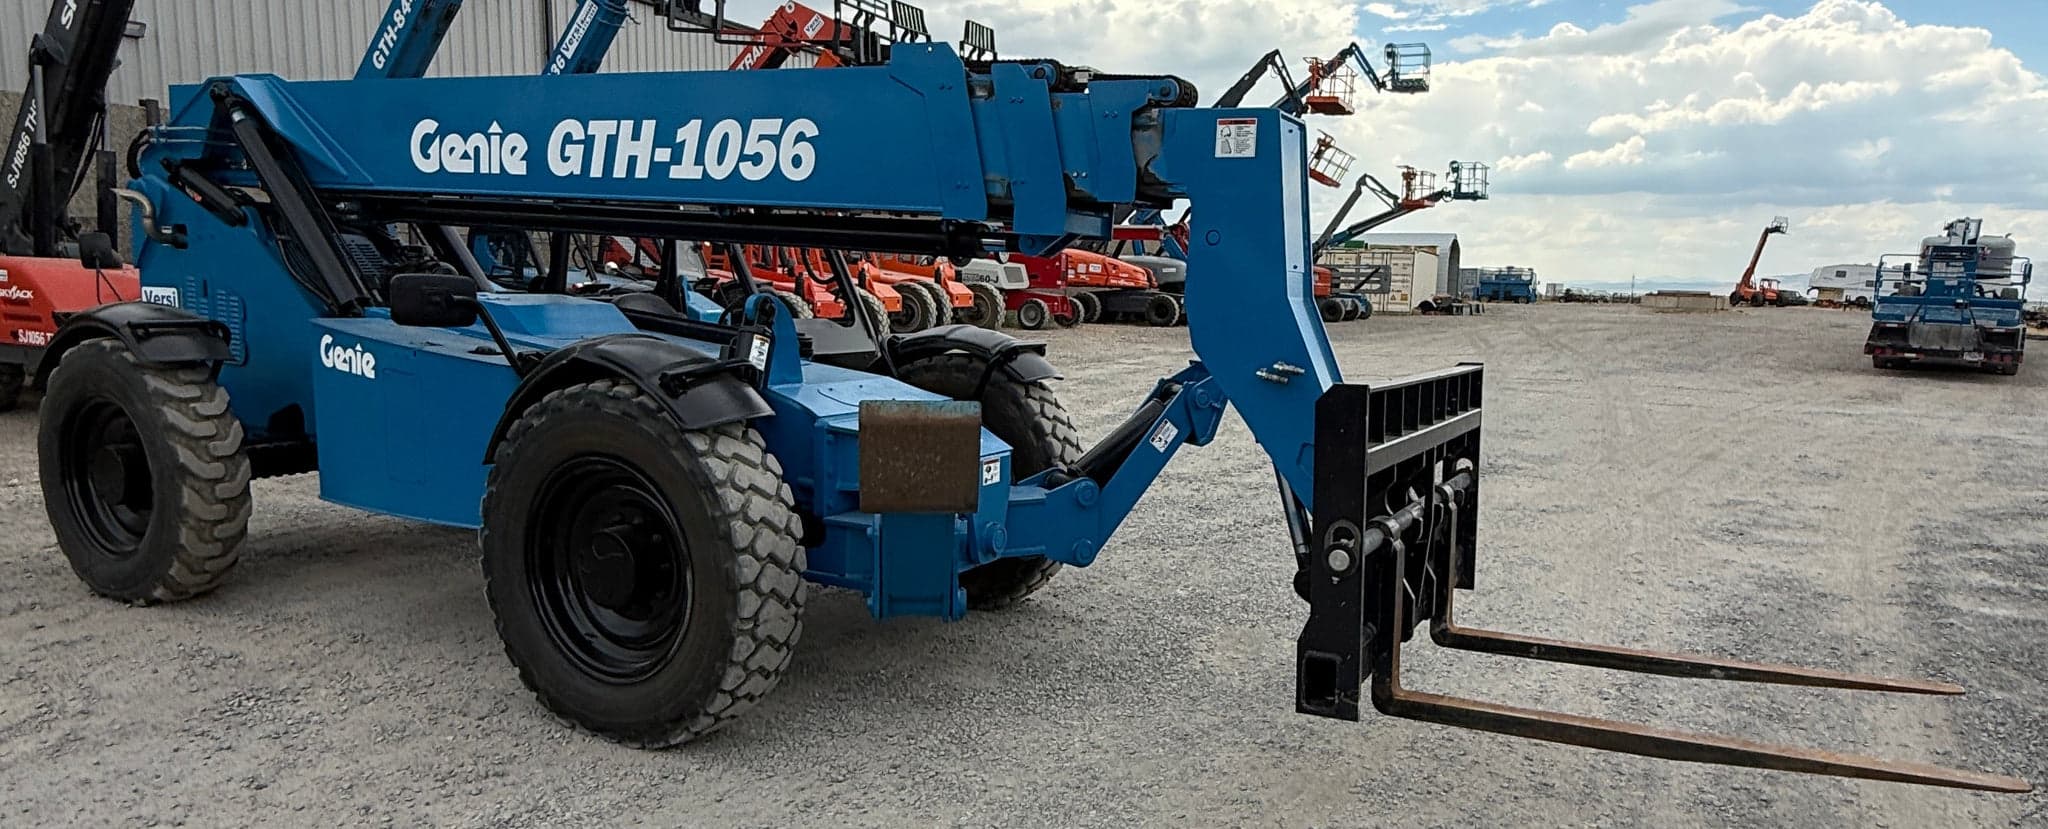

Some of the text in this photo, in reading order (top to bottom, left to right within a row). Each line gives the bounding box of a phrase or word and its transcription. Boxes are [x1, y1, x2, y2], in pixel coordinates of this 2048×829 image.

[373, 0, 413, 69] GTH-84
[548, 54, 566, 76] 36
[7, 131, 31, 189] SJ1056
[410, 118, 820, 181] Genie GTH-1056
[143, 289, 177, 308] Versi
[18, 328, 45, 346] SJ1056
[320, 334, 376, 379] Genie
